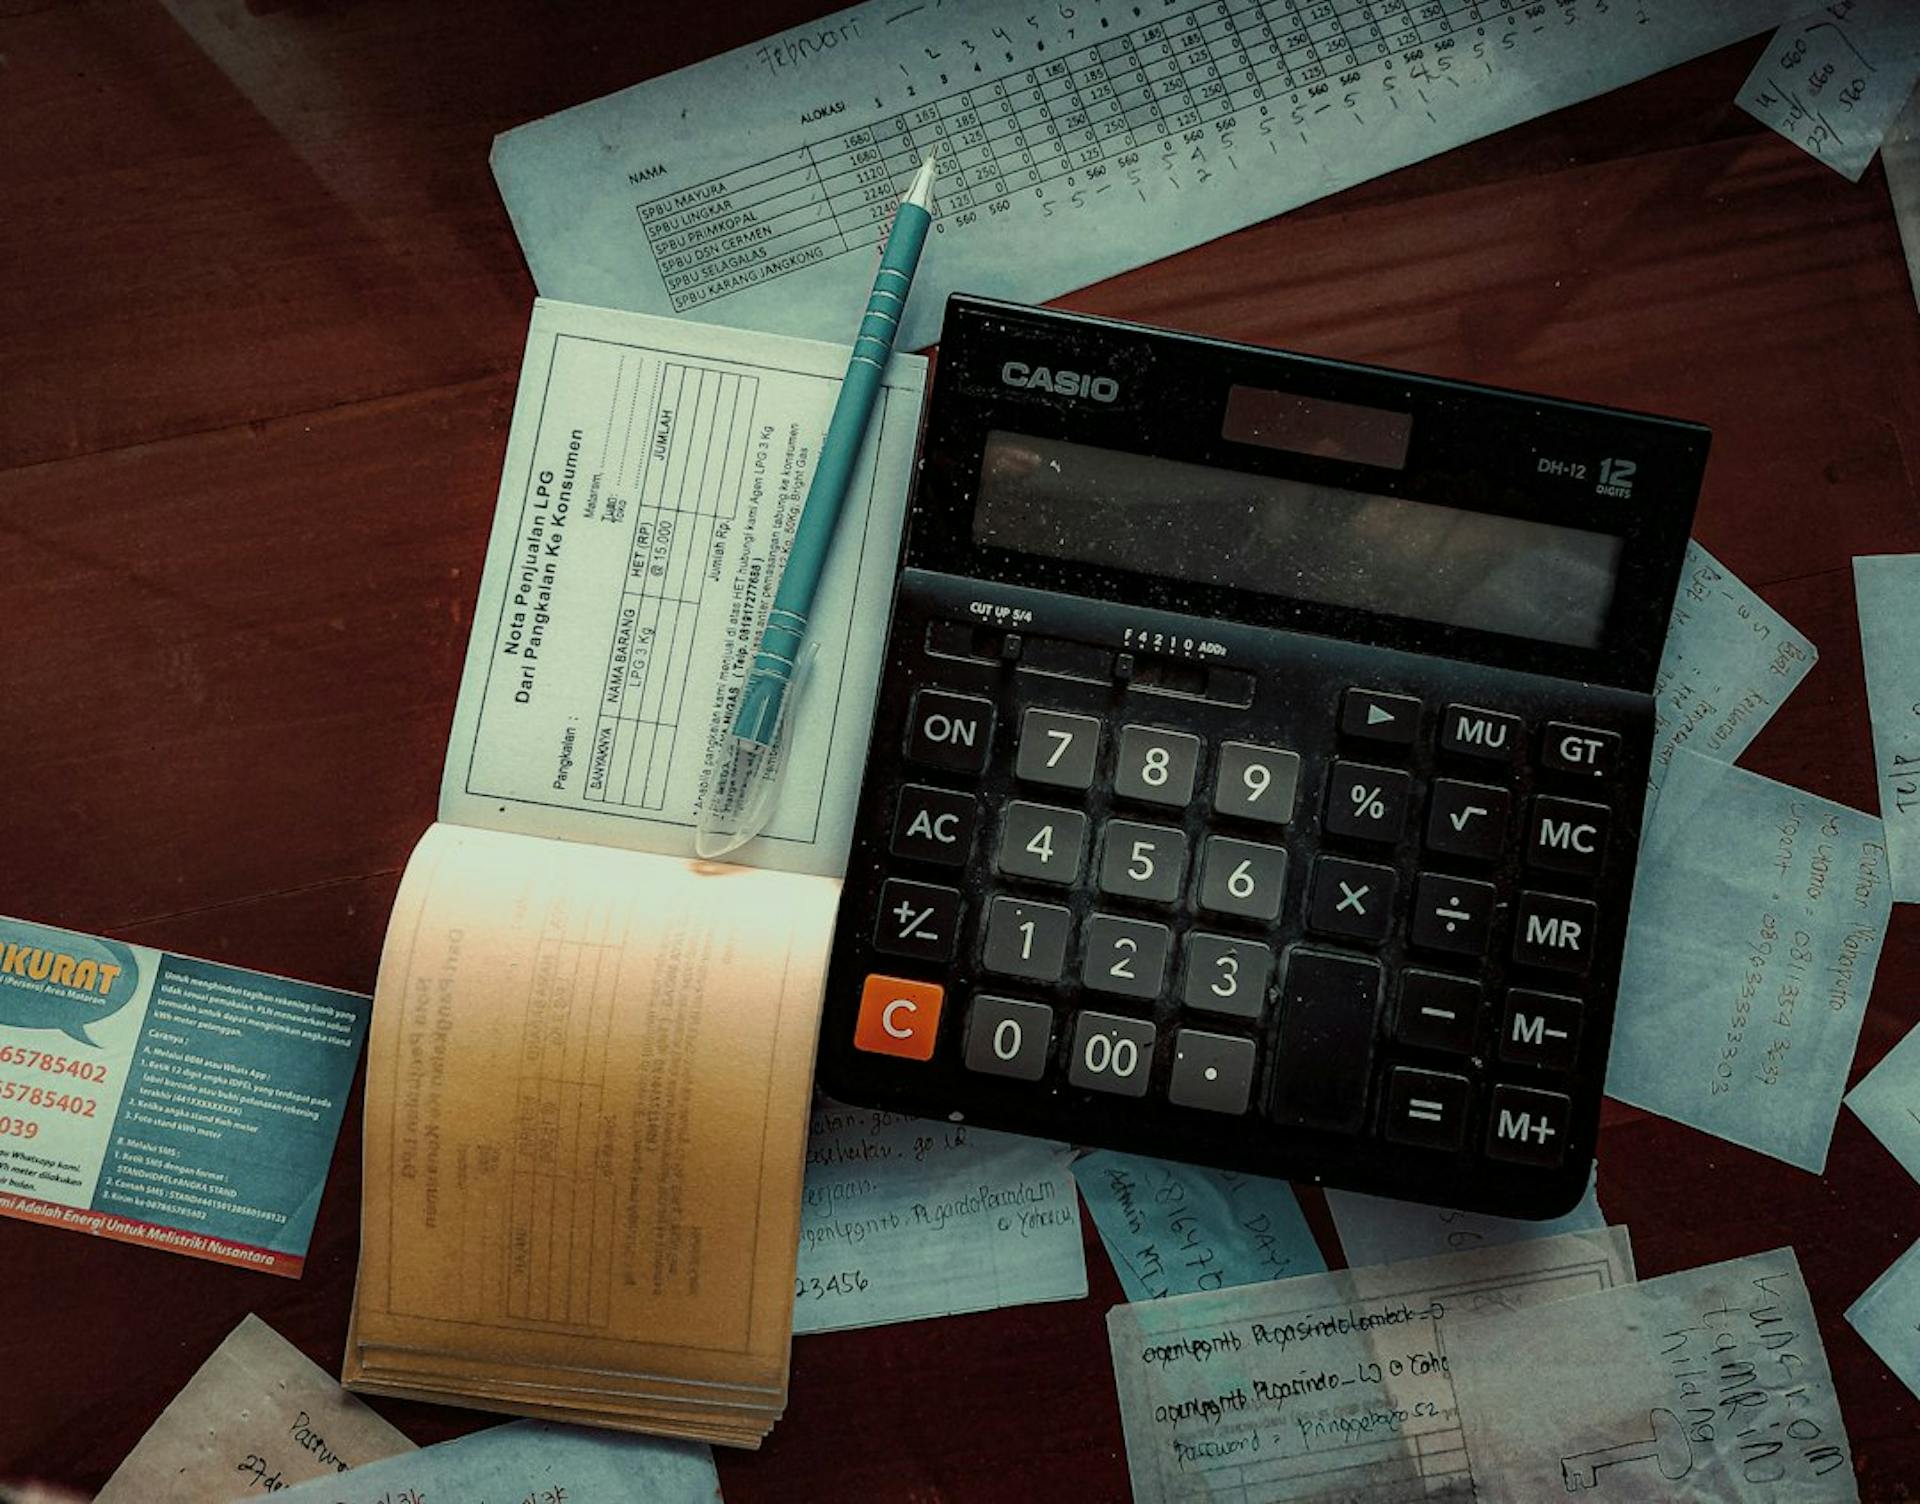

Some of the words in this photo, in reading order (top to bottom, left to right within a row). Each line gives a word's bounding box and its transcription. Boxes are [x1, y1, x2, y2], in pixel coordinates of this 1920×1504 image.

[628, 164, 667, 185] NAMA
[801, 101, 846, 125] ALOKASI
[641, 203, 672, 220] SPBU
[676, 183, 727, 207] MAYURA
[844, 132, 872, 149] 1680
[648, 221, 679, 237] SPBU
[683, 200, 733, 224] LINGKAR
[850, 149, 878, 167] 1680
[655, 239, 686, 255] SPBU
[688, 211, 758, 243] PRIMKOPAL
[661, 256, 692, 273] SPBU
[697, 246, 719, 261] DSN
[722, 226, 772, 250] CERMEN
[864, 183, 891, 200] 2240
[668, 273, 699, 290] SPBU
[702, 247, 767, 278] SELAGALAS
[675, 291, 706, 309] SPBU
[709, 271, 758, 295] KARANG
[760, 246, 824, 280] JANGKONG
[1002, 362, 1119, 402] CASIO
[652, 408, 674, 461] JUMLAH
[757, 440, 769, 449] 3
[759, 423, 775, 441] Kg
[550, 427, 583, 528] Konsumen
[752, 450, 768, 474] LPG
[1599, 458, 1637, 489] 12
[533, 469, 554, 509] LPG
[747, 475, 766, 505] Agen
[1595, 484, 1632, 499] DIGITS
[544, 531, 563, 557] Ke
[635, 519, 653, 549] (RP)
[652, 518, 673, 561] 15.000
[513, 513, 549, 607] Penjualan
[630, 552, 646, 577] HET
[707, 540, 727, 582] Jumlah
[731, 575, 746, 600] HET
[523, 561, 560, 661] Pangkalan
[969, 601, 993, 616] CUT
[994, 605, 1011, 618] UP
[1012, 609, 1033, 623] 5/4
[503, 610, 526, 655] Nota
[615, 606, 636, 662] BARANG
[635, 646, 648, 656] 3
[637, 625, 655, 645] Kg
[1125, 628, 1133, 641] F
[1138, 631, 1148, 644] 4
[1153, 633, 1164, 646] 2
[1183, 638, 1194, 651] 0
[514, 664, 536, 704] Dari
[607, 665, 625, 704] NAMA
[628, 658, 646, 687] LPG
[924, 714, 976, 746] ON
[1047, 730, 1072, 766] 7
[1457, 712, 1508, 747] MU
[1561, 730, 1605, 763] GT
[552, 726, 579, 791] Pangkalan
[589, 726, 613, 790] BANYAKNYA
[1142, 748, 1169, 785] 8
[1244, 765, 1270, 801] 9
[1352, 785, 1384, 818] %
[907, 810, 959, 842] AC
[1027, 826, 1053, 862] 4
[1540, 819, 1596, 852] MC
[1128, 842, 1154, 880] 5
[1228, 861, 1254, 897] 6
[1020, 922, 1034, 959] 1
[1527, 915, 1581, 950] MR
[0, 942, 121, 994] KURAT
[1111, 939, 1136, 978] 2
[1212, 958, 1238, 996] 3
[883, 1000, 916, 1037] C
[995, 1020, 1021, 1059] 0
[1086, 1035, 1137, 1076] 00
[0, 1046, 108, 1083] 65785402
[0, 1080, 97, 1118] 5785402
[1498, 1110, 1555, 1144] M+
[18, 1199, 62, 1219] Adalah
[63, 1209, 104, 1230] Energi
[106, 1219, 147, 1237] Untuk
[149, 1227, 207, 1250] Melistriki
[207, 1240, 275, 1266] Nusantara
